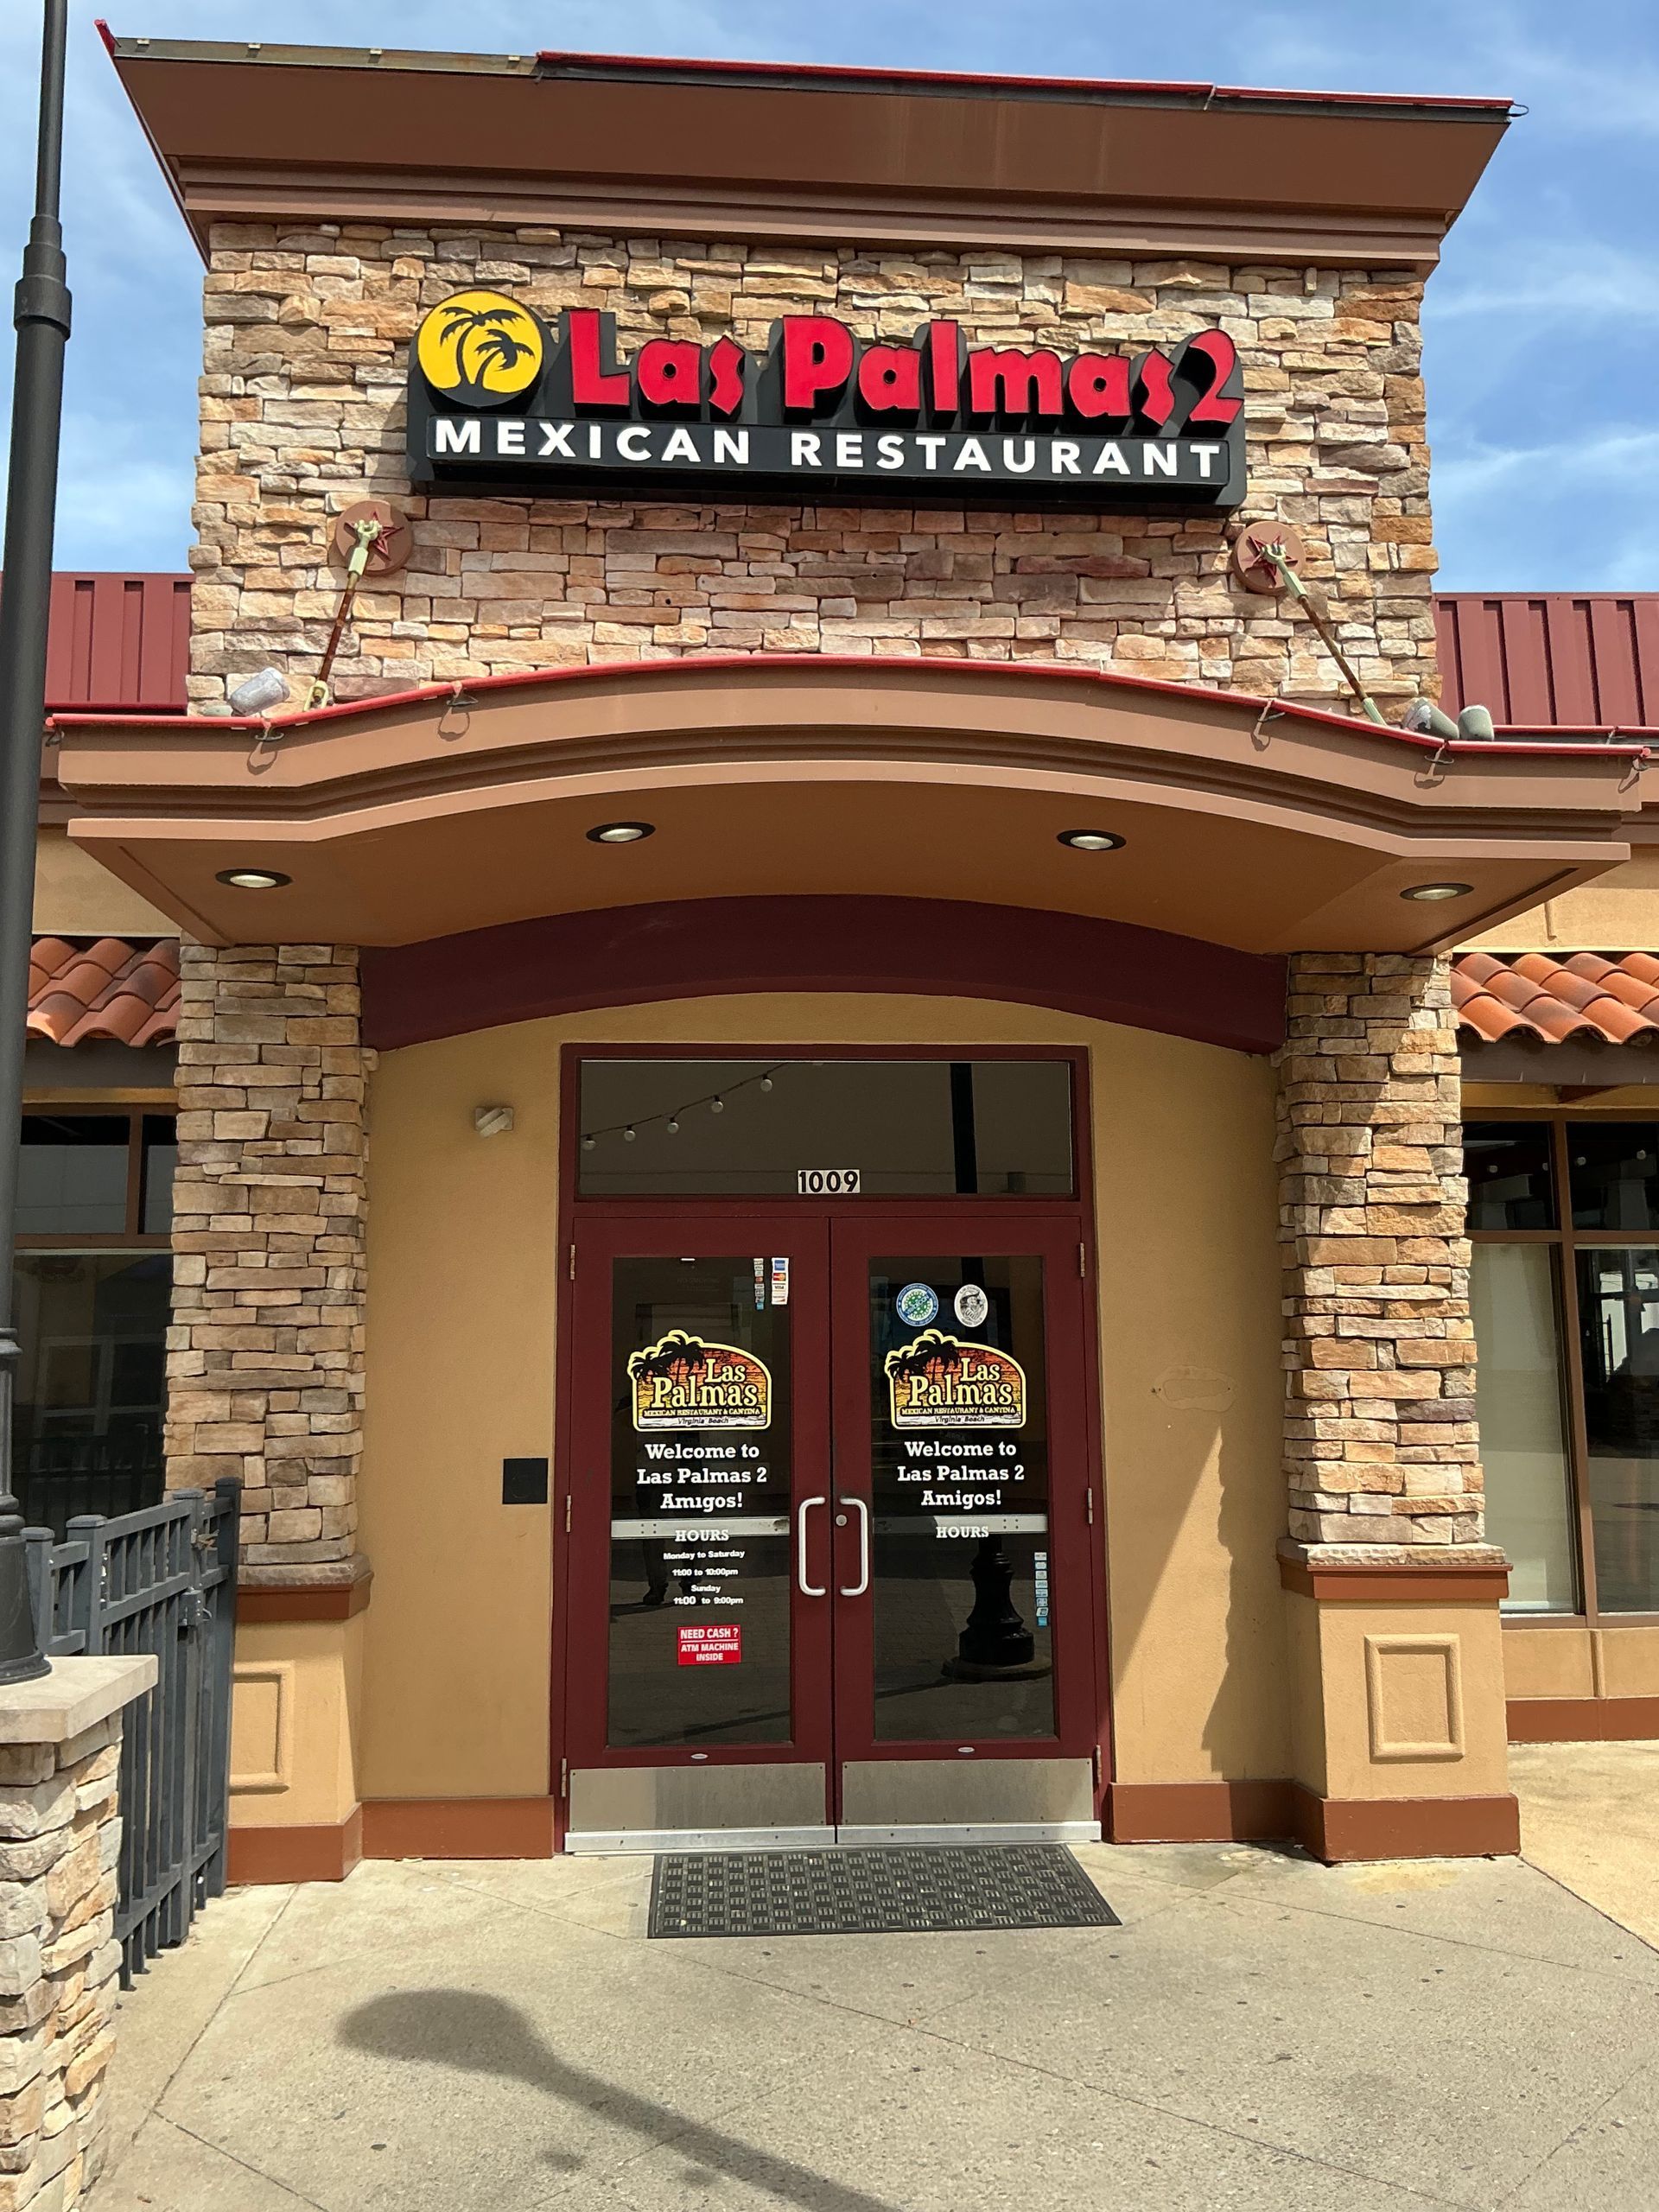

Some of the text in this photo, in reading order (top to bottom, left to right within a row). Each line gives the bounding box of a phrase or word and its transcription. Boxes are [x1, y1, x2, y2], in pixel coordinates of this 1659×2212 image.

[569, 309, 1245, 426] Las Palmas 2
[434, 418, 1222, 480] MEXICAN RESTAURANT
[799, 1171, 858, 1192] 1009
[705, 1358, 746, 1382] Las
[960, 1357, 1000, 1381] Las
[651, 1376, 758, 1408] Palmas
[908, 1375, 1013, 1406] Palmas
[645, 1444, 760, 1459] Welcome to
[905, 1441, 1017, 1457] Welcome to
[637, 1467, 767, 1484] Las Palmas 2
[897, 1465, 1025, 1481] Las Palmas 2
[920, 1490, 1001, 1510] Amigos!
[675, 1529, 729, 1541] HOURS
[936, 1526, 989, 1538] HOURS
[708, 1550, 745, 1559] Saturday
[691, 1585, 721, 1593] Sunday
[714, 1597, 743, 1605] 9:00pm
[680, 1628, 739, 1639] NEED CASH ?
[701, 1643, 739, 1651] MACHINE
